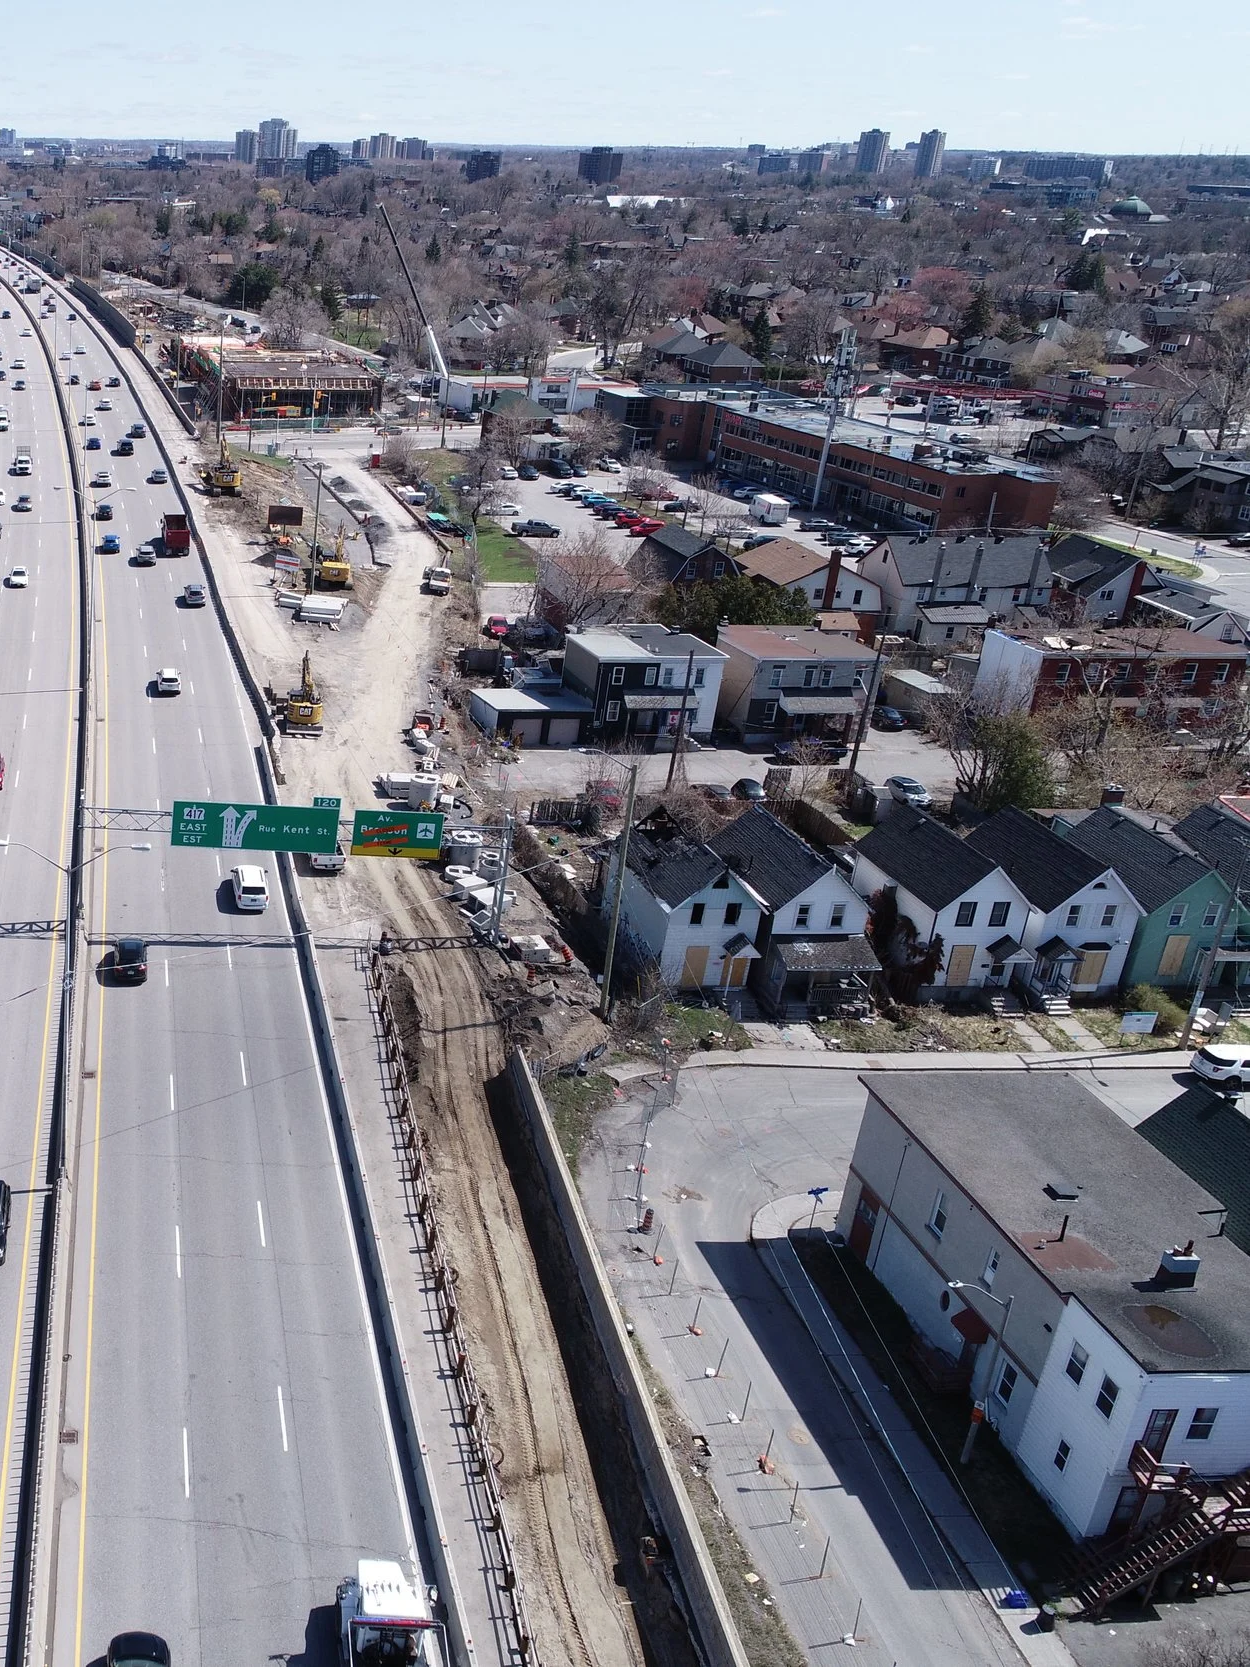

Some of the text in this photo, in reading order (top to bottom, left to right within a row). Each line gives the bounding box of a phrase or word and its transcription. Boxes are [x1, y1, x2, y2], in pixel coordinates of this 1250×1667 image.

[300, 707, 313, 716] CAT
[317, 799, 337, 807] 120
[186, 809, 203, 819] 417
[180, 823, 207, 831] EAST
[258, 825, 330, 836] Rue Kent St.
[183, 835, 202, 843] EST
